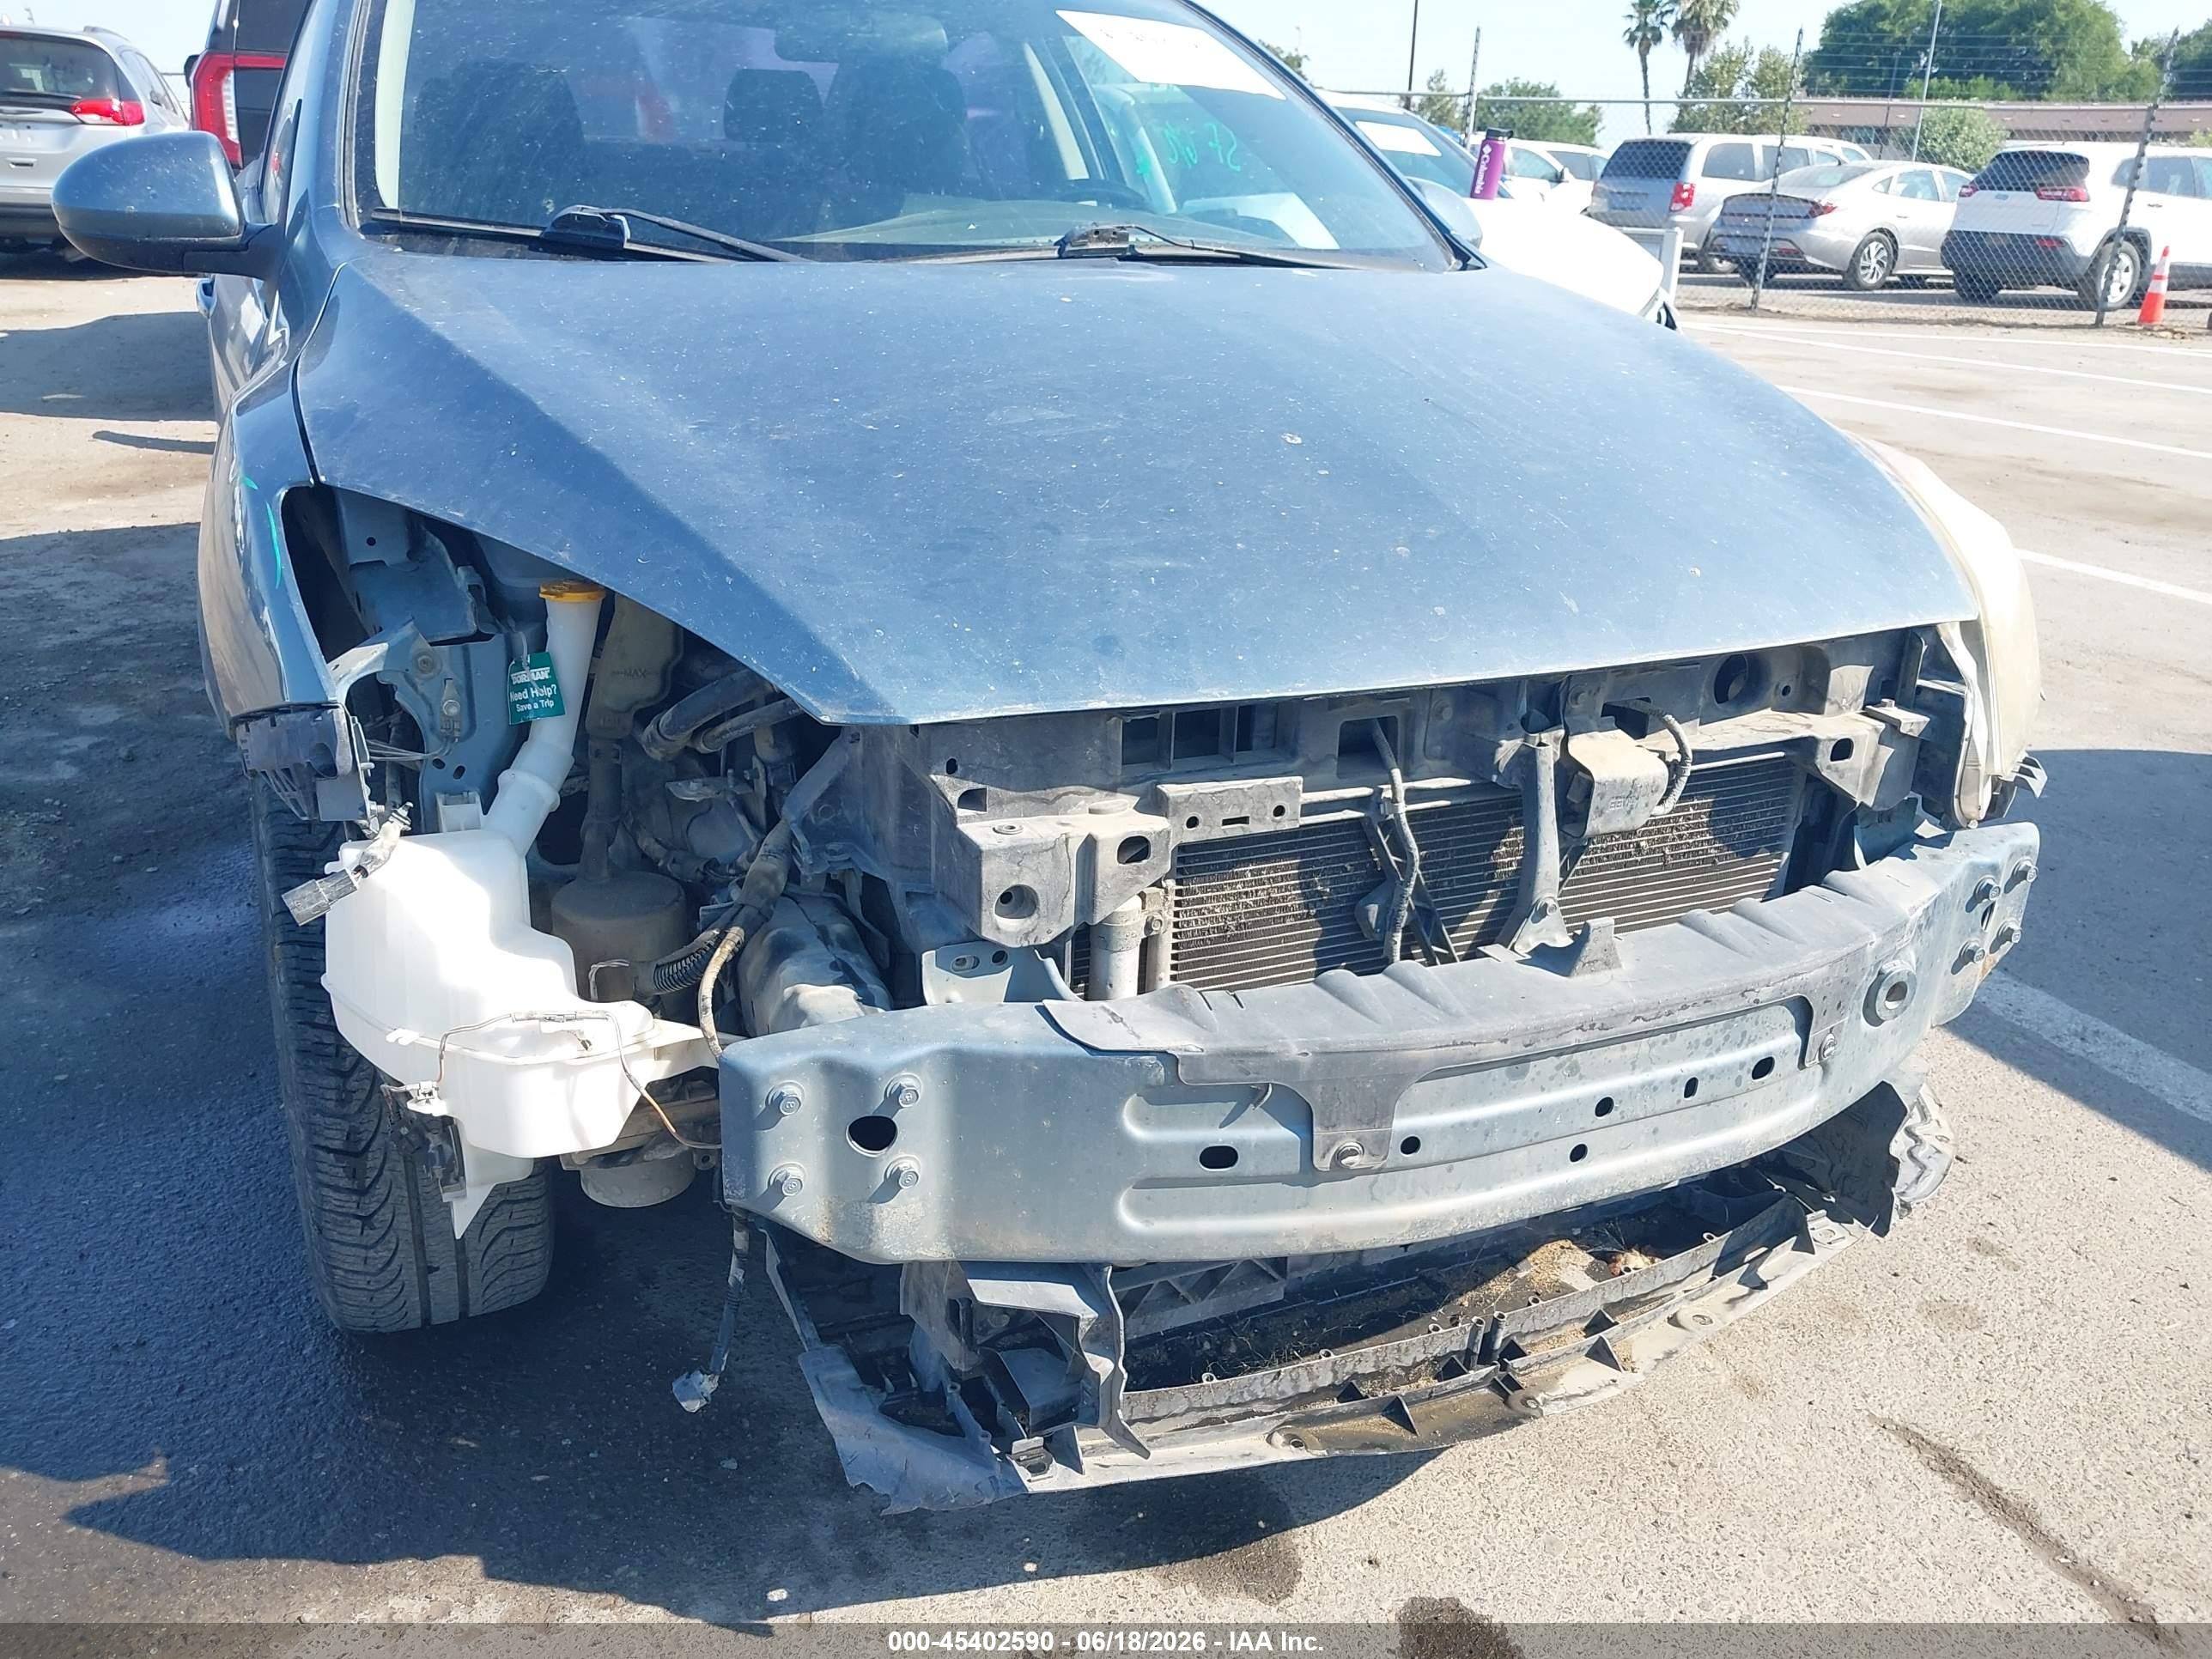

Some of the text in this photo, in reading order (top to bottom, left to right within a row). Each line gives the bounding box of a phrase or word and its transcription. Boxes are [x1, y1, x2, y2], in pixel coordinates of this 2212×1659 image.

[510, 684, 556, 702] Need Help?
[516, 703, 532, 713] Save
[539, 699, 554, 708] Trip
